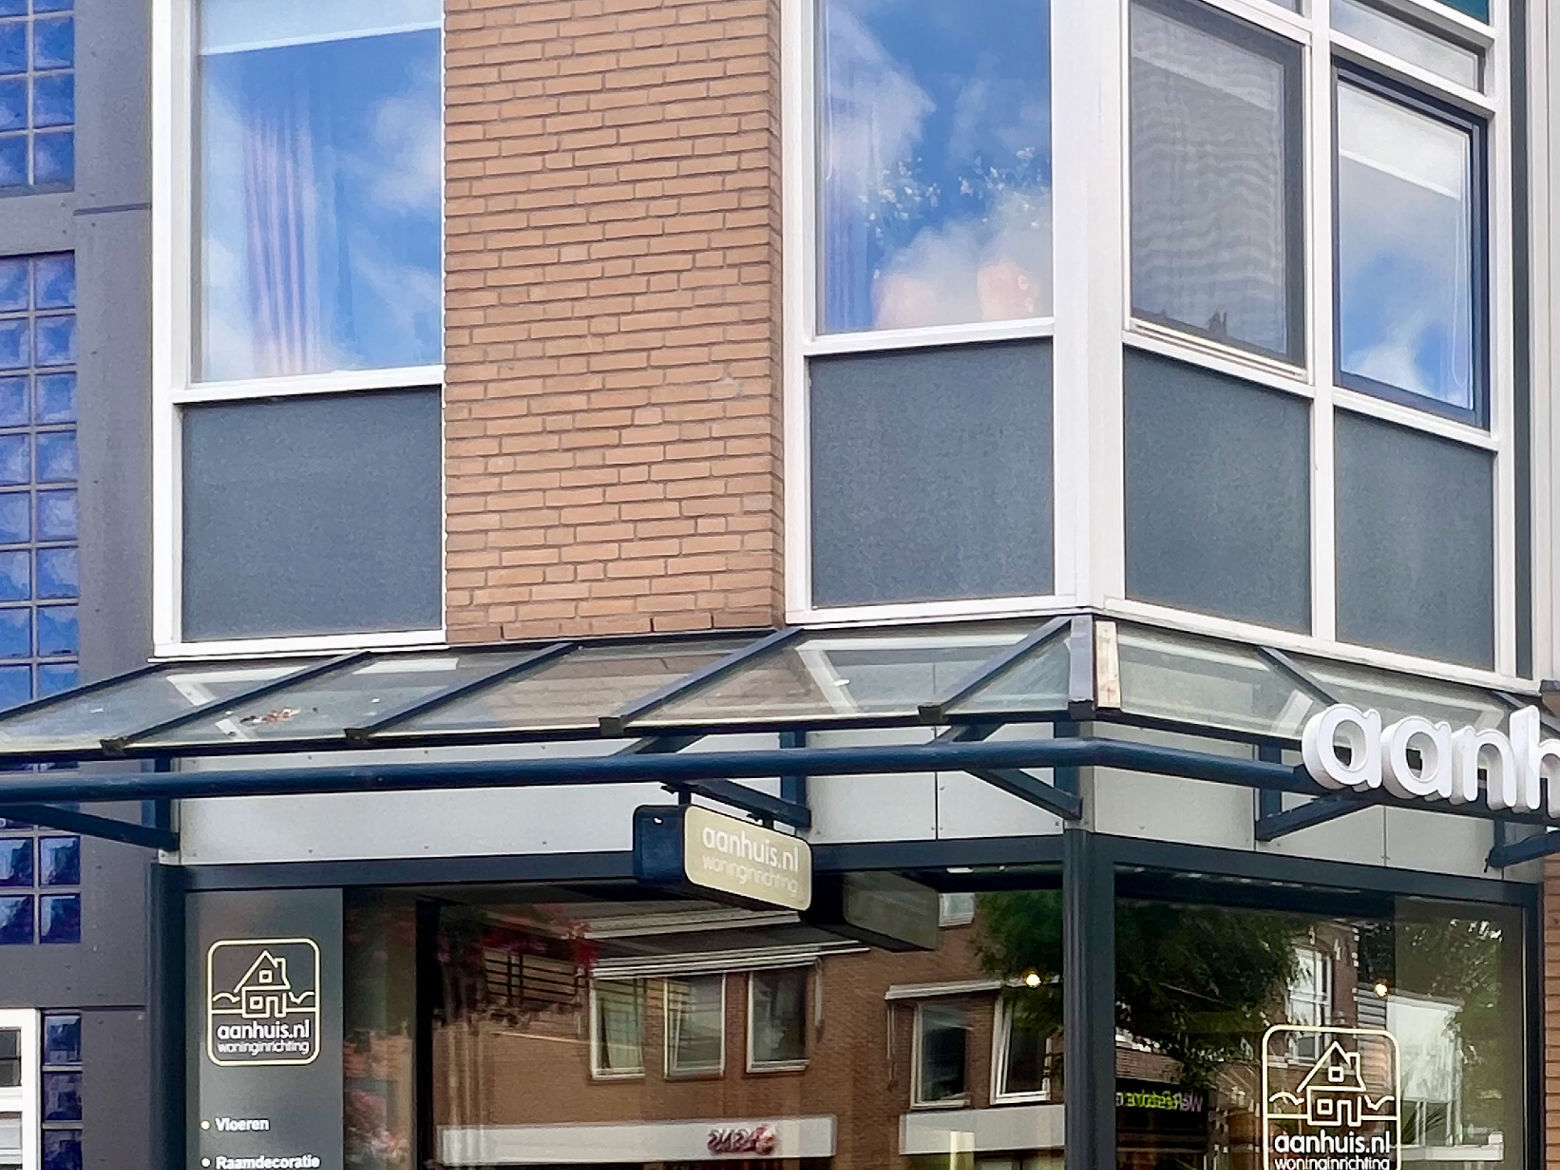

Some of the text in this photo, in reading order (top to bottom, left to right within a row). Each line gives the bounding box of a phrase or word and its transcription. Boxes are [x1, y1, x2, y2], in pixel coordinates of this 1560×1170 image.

[702, 827, 799, 872] aanhuis.nl
[216, 1019, 310, 1040] aanhuis.nl
[216, 1040, 310, 1056] woninginrichting
[215, 1117, 270, 1132] Vloeren
[1273, 1129, 1391, 1154] aanhuis.nl
[215, 1154, 321, 1170] Raamdecoratie
